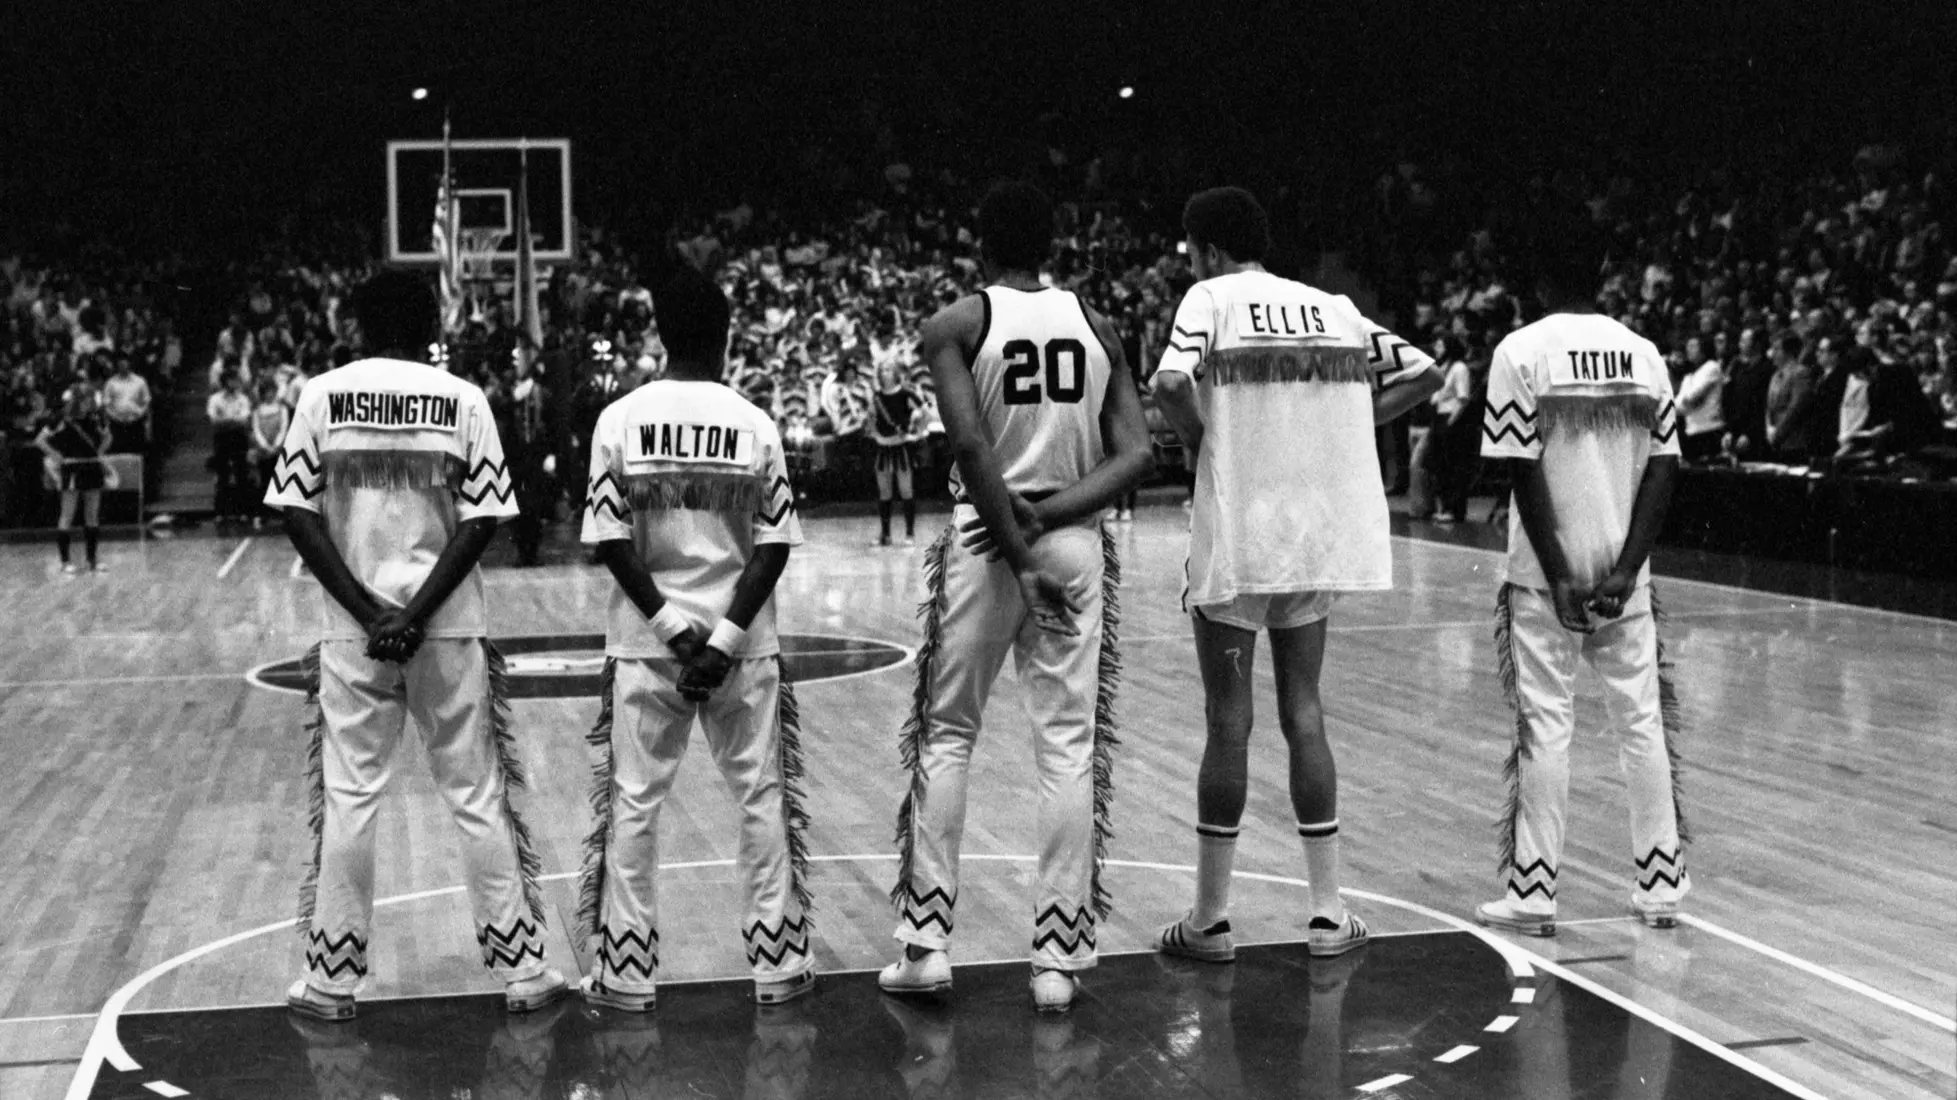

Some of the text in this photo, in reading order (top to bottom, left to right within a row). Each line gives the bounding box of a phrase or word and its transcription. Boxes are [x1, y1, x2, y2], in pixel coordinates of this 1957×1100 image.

[1249, 303, 1325, 334] ELLIS
[1002, 338, 1086, 405] 20
[1567, 350, 1633, 381] TATUM
[328, 391, 459, 428] WASHINGTON
[639, 423, 739, 460] WALTON
